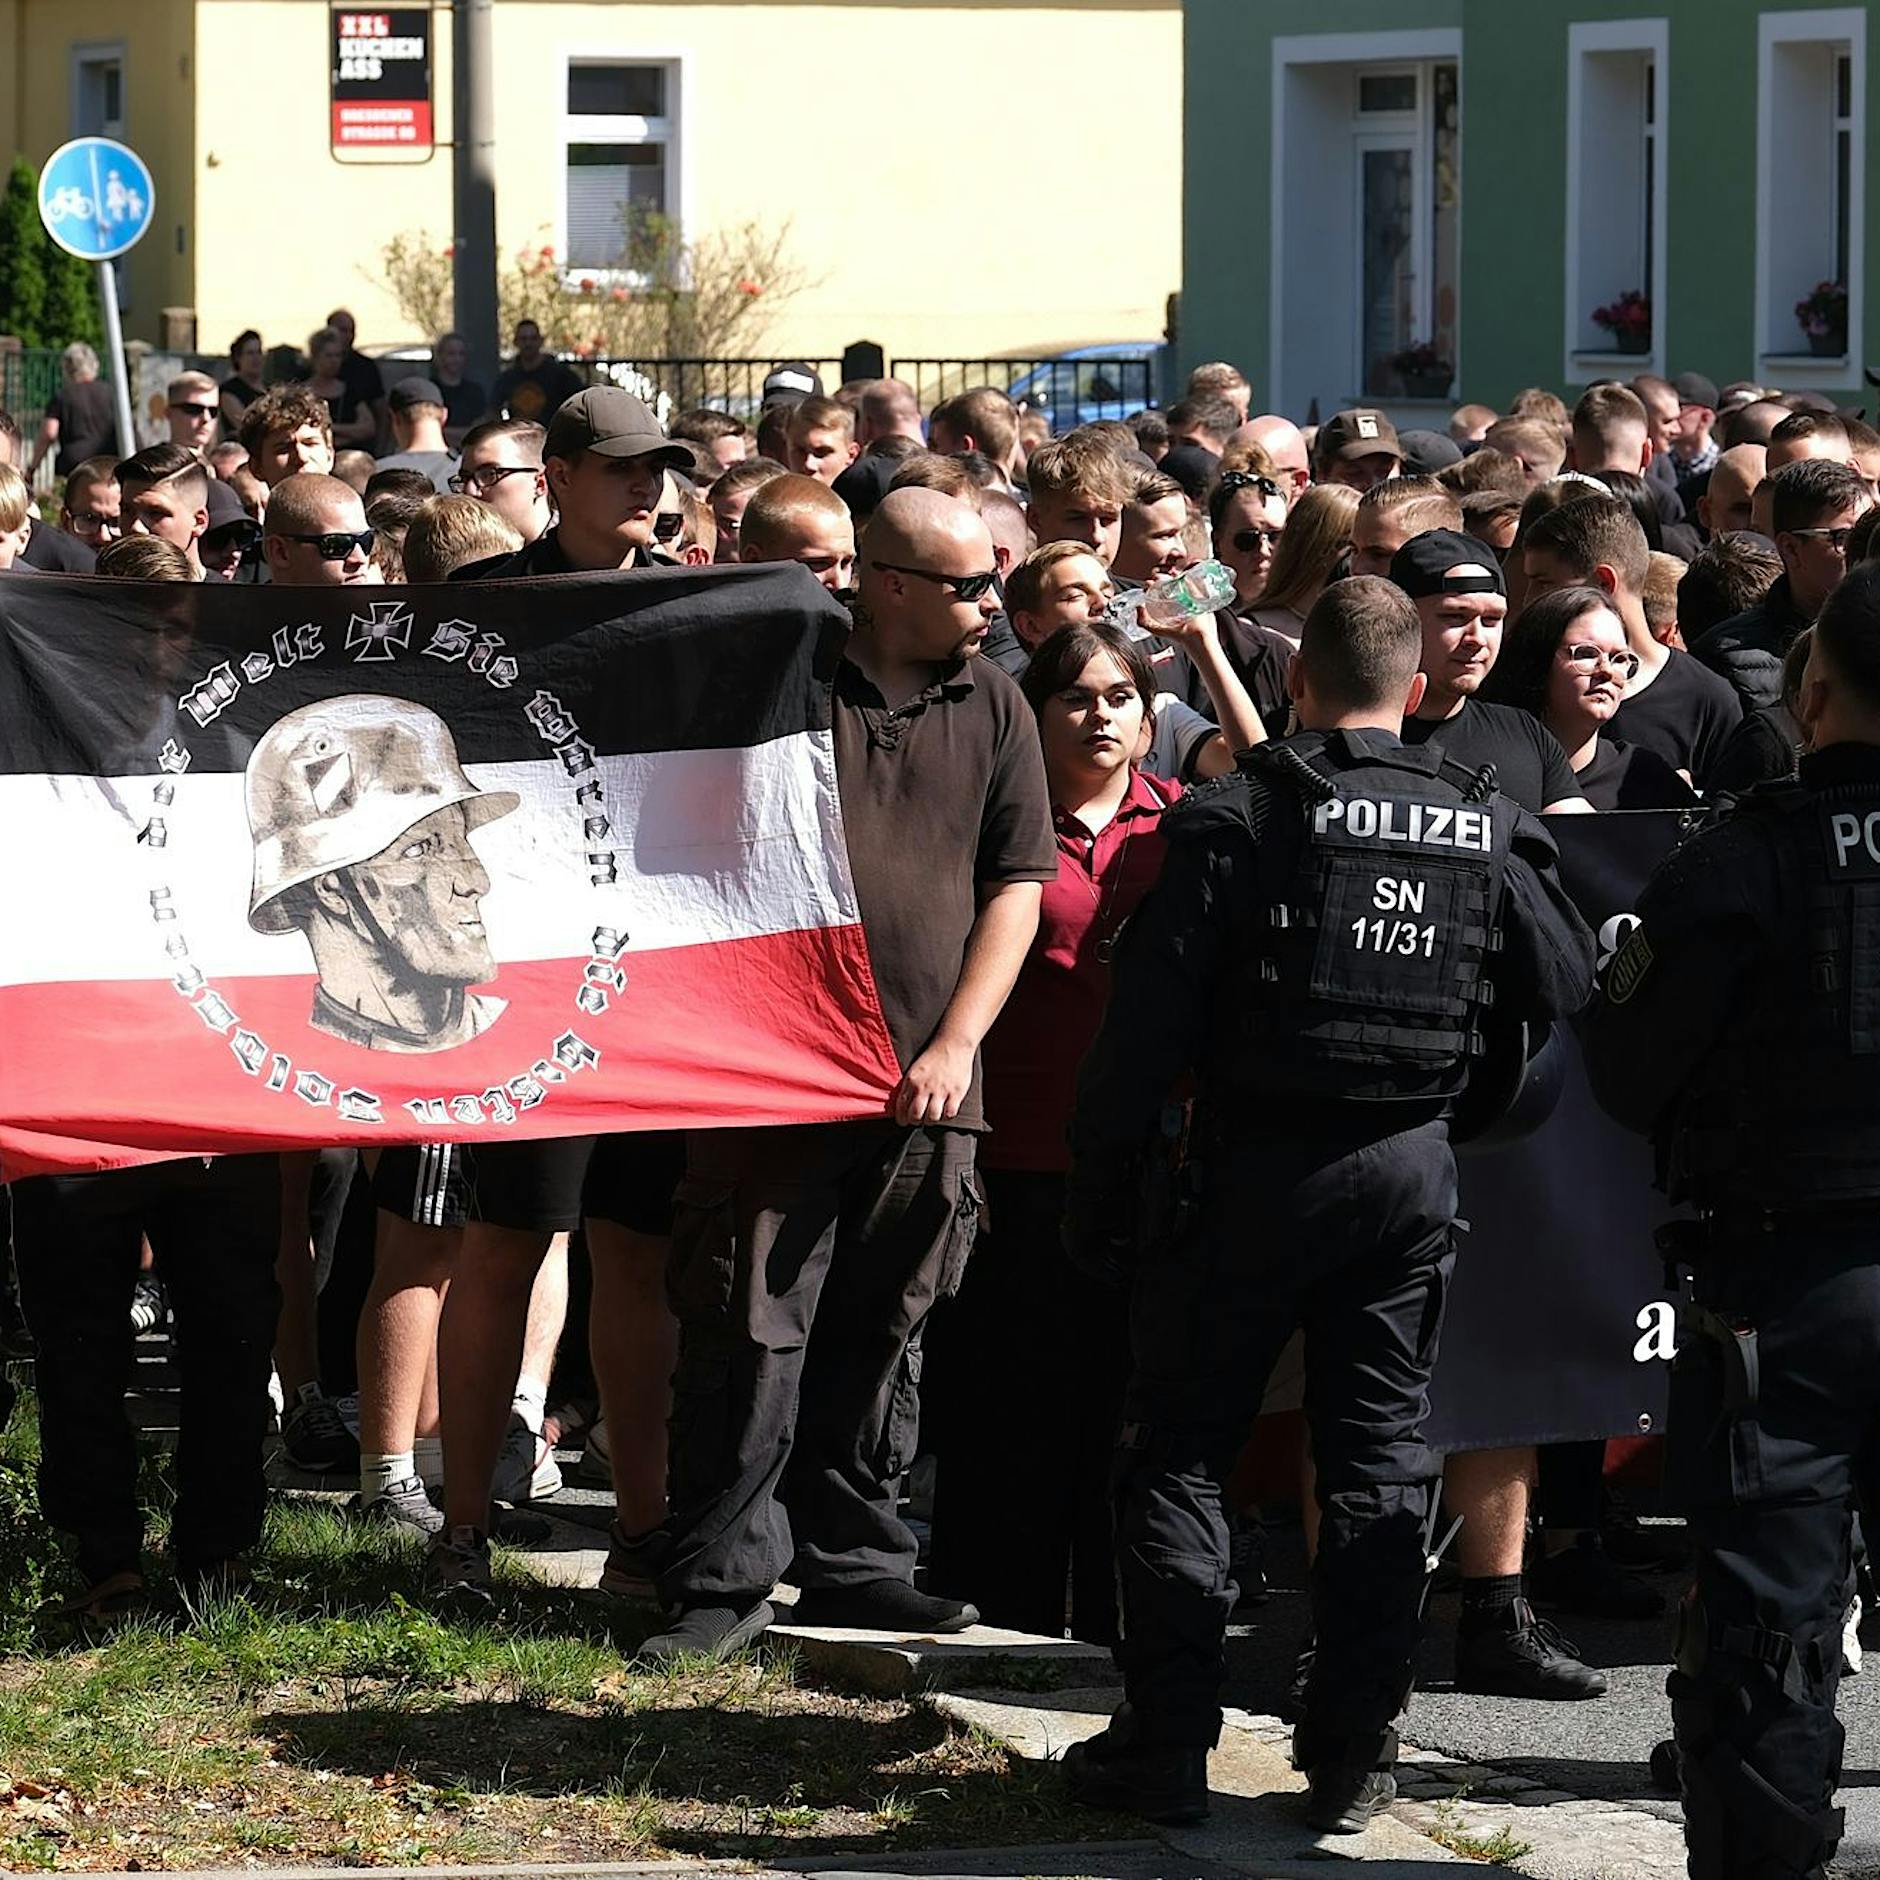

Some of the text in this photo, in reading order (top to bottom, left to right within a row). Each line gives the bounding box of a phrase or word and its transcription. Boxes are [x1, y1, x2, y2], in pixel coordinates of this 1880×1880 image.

[340, 15, 389, 36] XXL
[339, 58, 382, 80] ASS
[421, 618, 519, 689] Sie
[576, 926, 629, 1015] die
[1314, 798, 1491, 852] POLIZEI
[1372, 876, 1425, 914] SN
[1351, 917, 1436, 958] 11/31
